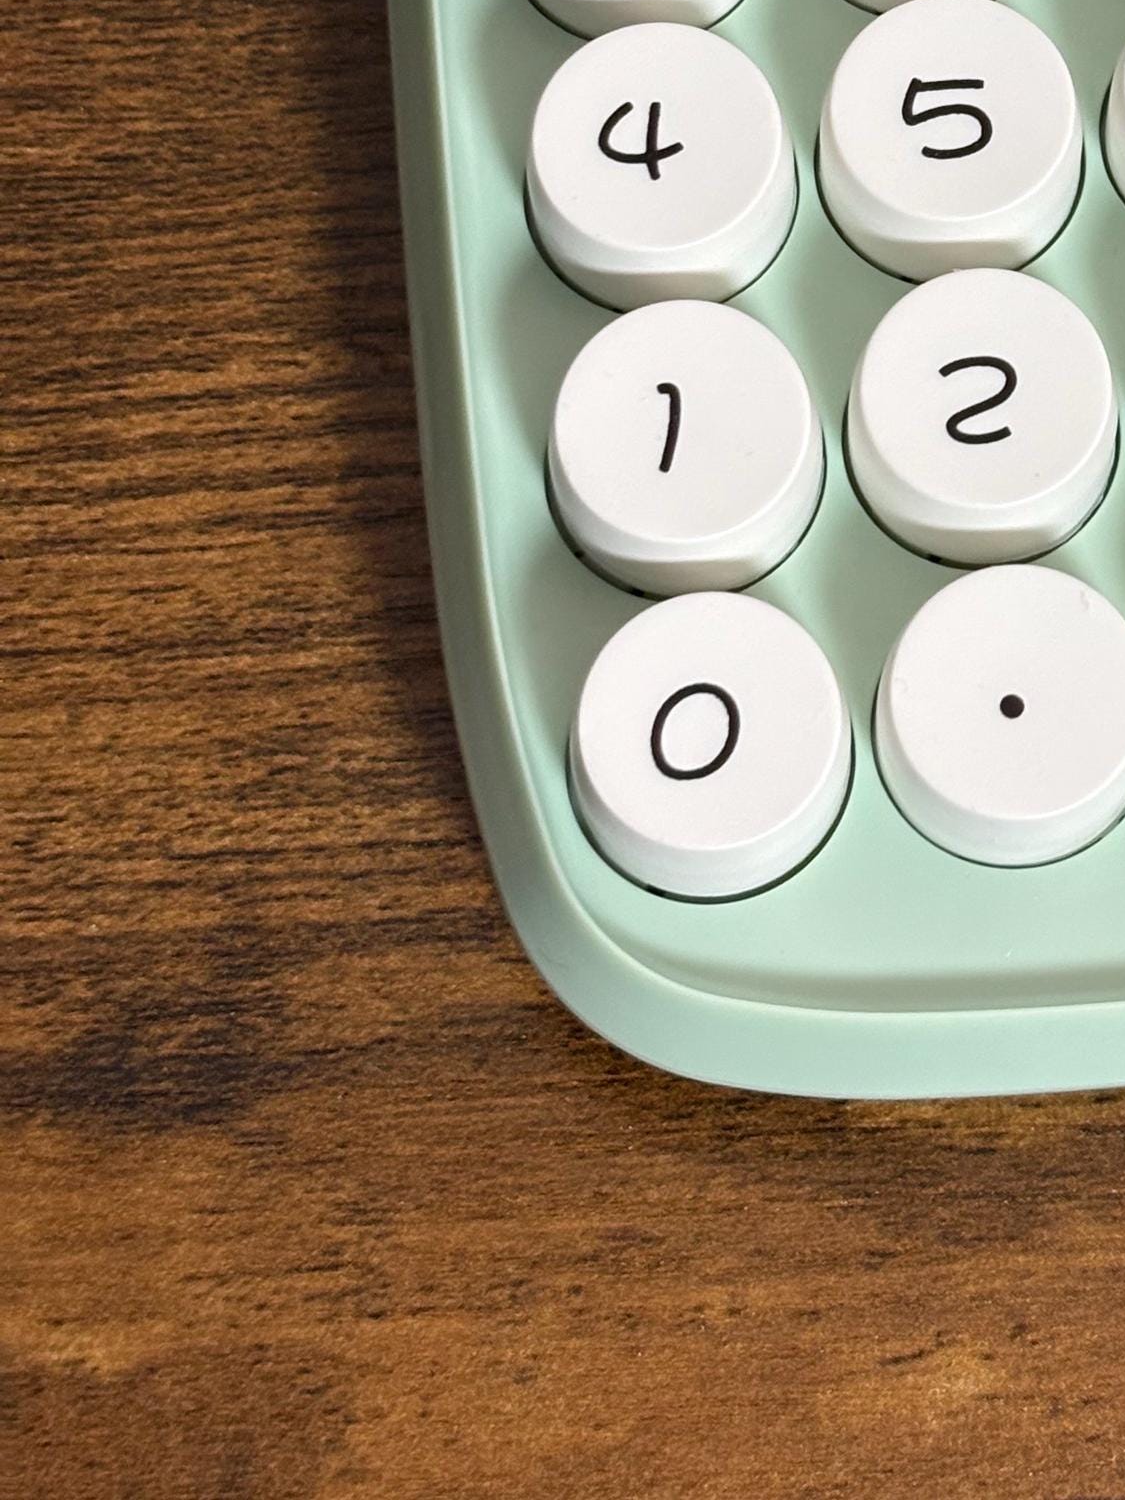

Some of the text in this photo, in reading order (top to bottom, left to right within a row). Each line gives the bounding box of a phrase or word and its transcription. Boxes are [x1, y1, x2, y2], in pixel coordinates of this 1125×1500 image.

[597, 101, 684, 181] 4
[901, 77, 993, 160] 5
[656, 382, 681, 473] 1
[938, 355, 1018, 445] 2
[649, 682, 741, 781] 0
